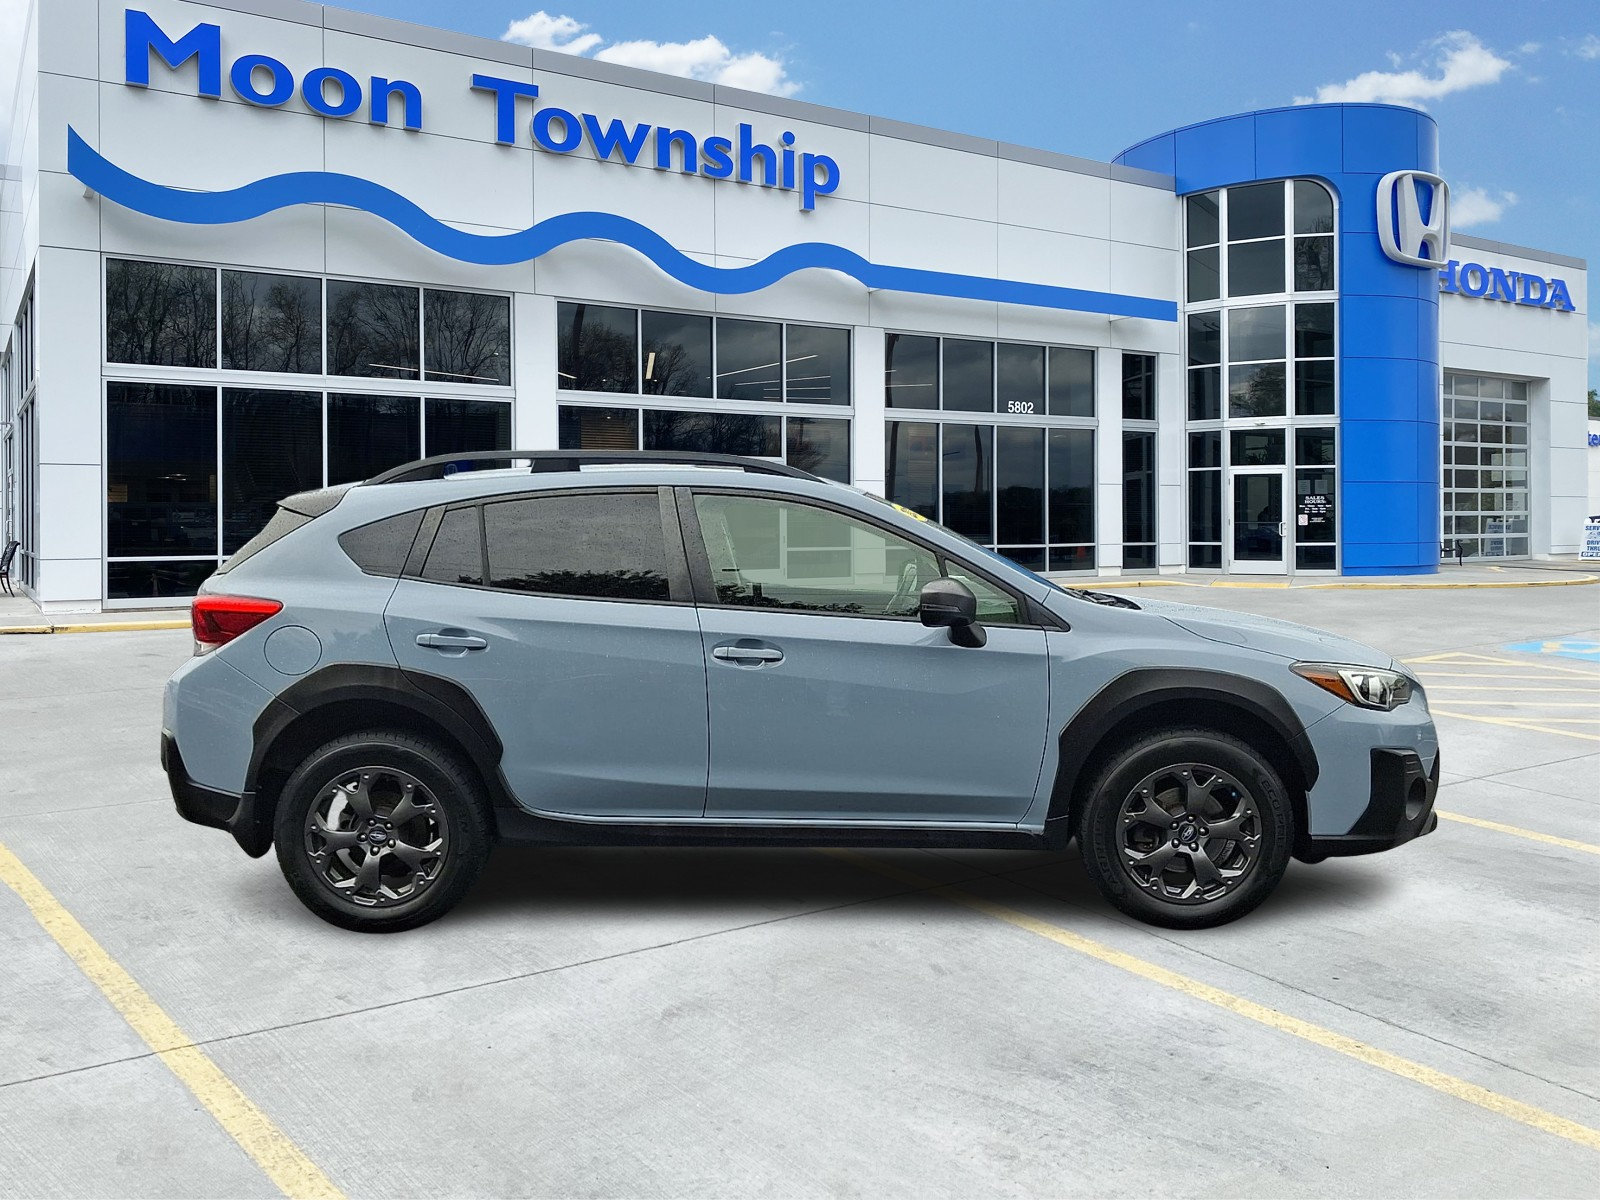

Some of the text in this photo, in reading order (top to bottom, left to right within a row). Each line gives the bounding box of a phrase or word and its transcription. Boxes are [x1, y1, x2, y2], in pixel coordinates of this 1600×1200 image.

[125, 9, 840, 212] Moon Township
[1439, 260, 1576, 311] HONDA
[1007, 400, 1034, 414] 5802
